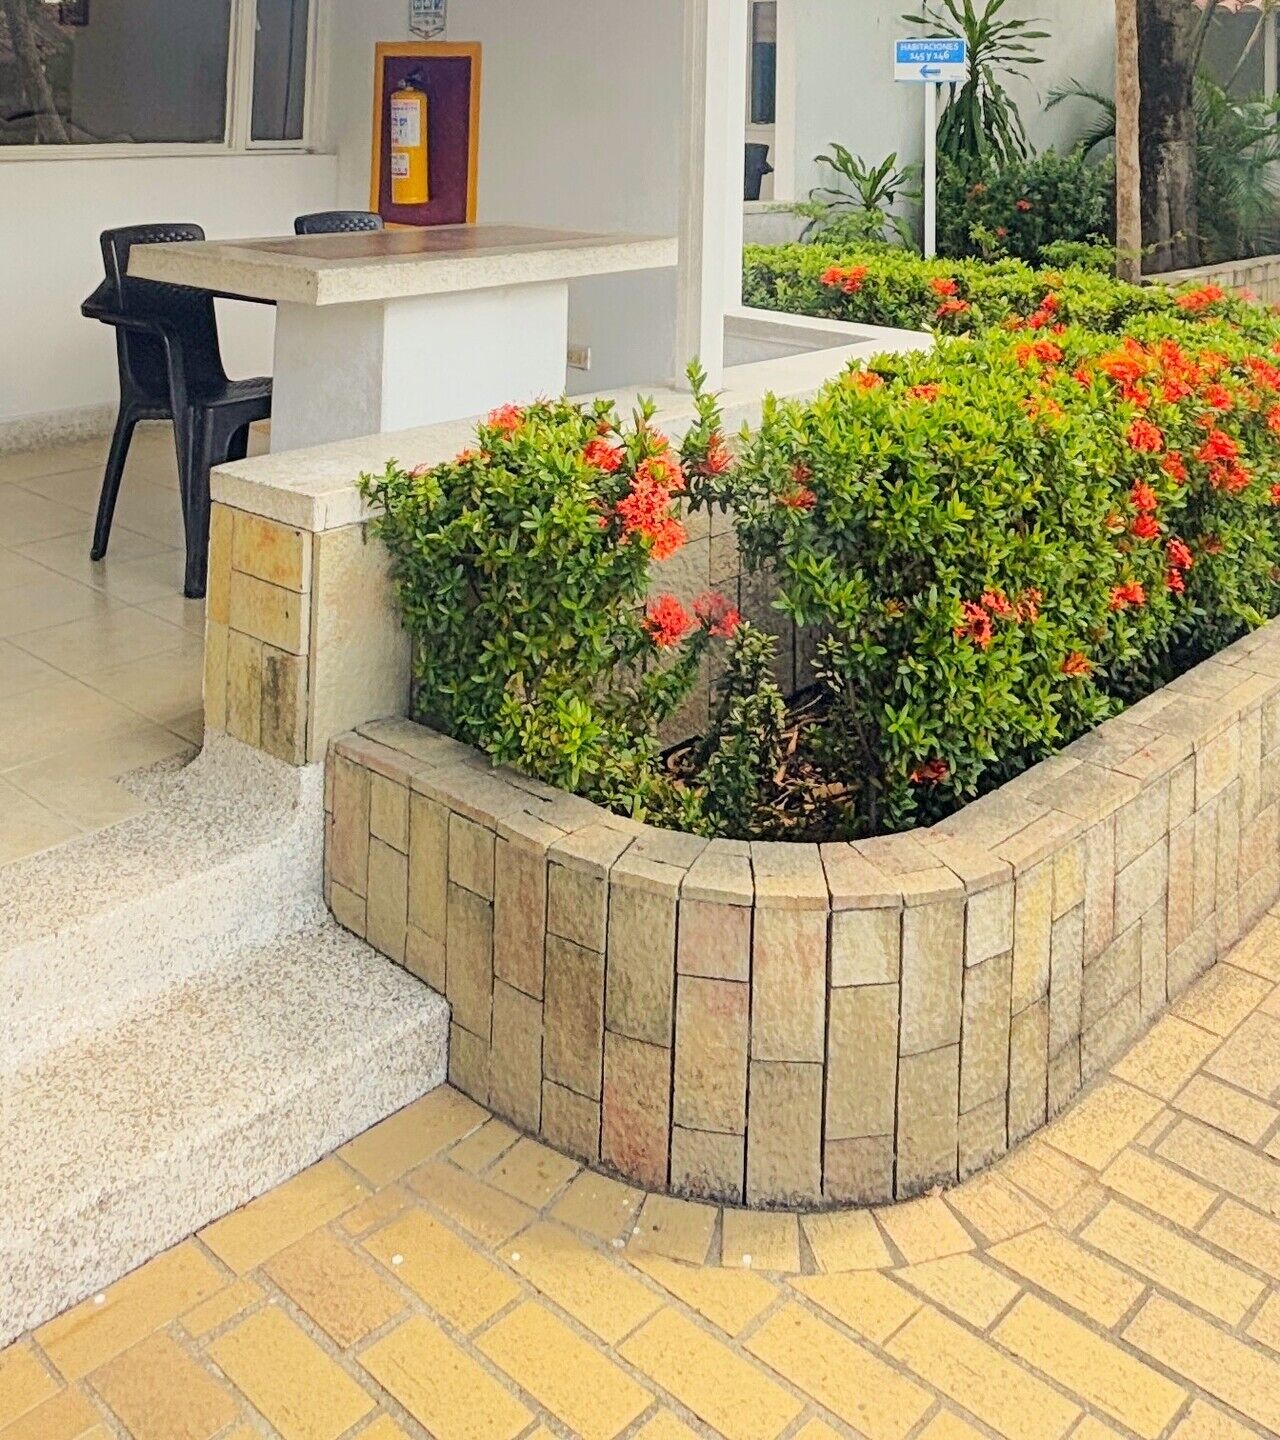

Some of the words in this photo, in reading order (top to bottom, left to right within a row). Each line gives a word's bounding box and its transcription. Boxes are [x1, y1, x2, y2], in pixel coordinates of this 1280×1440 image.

[900, 42, 959, 51] HABITACIONES
[910, 52, 925, 61] 145
[933, 50, 950, 61] 146
